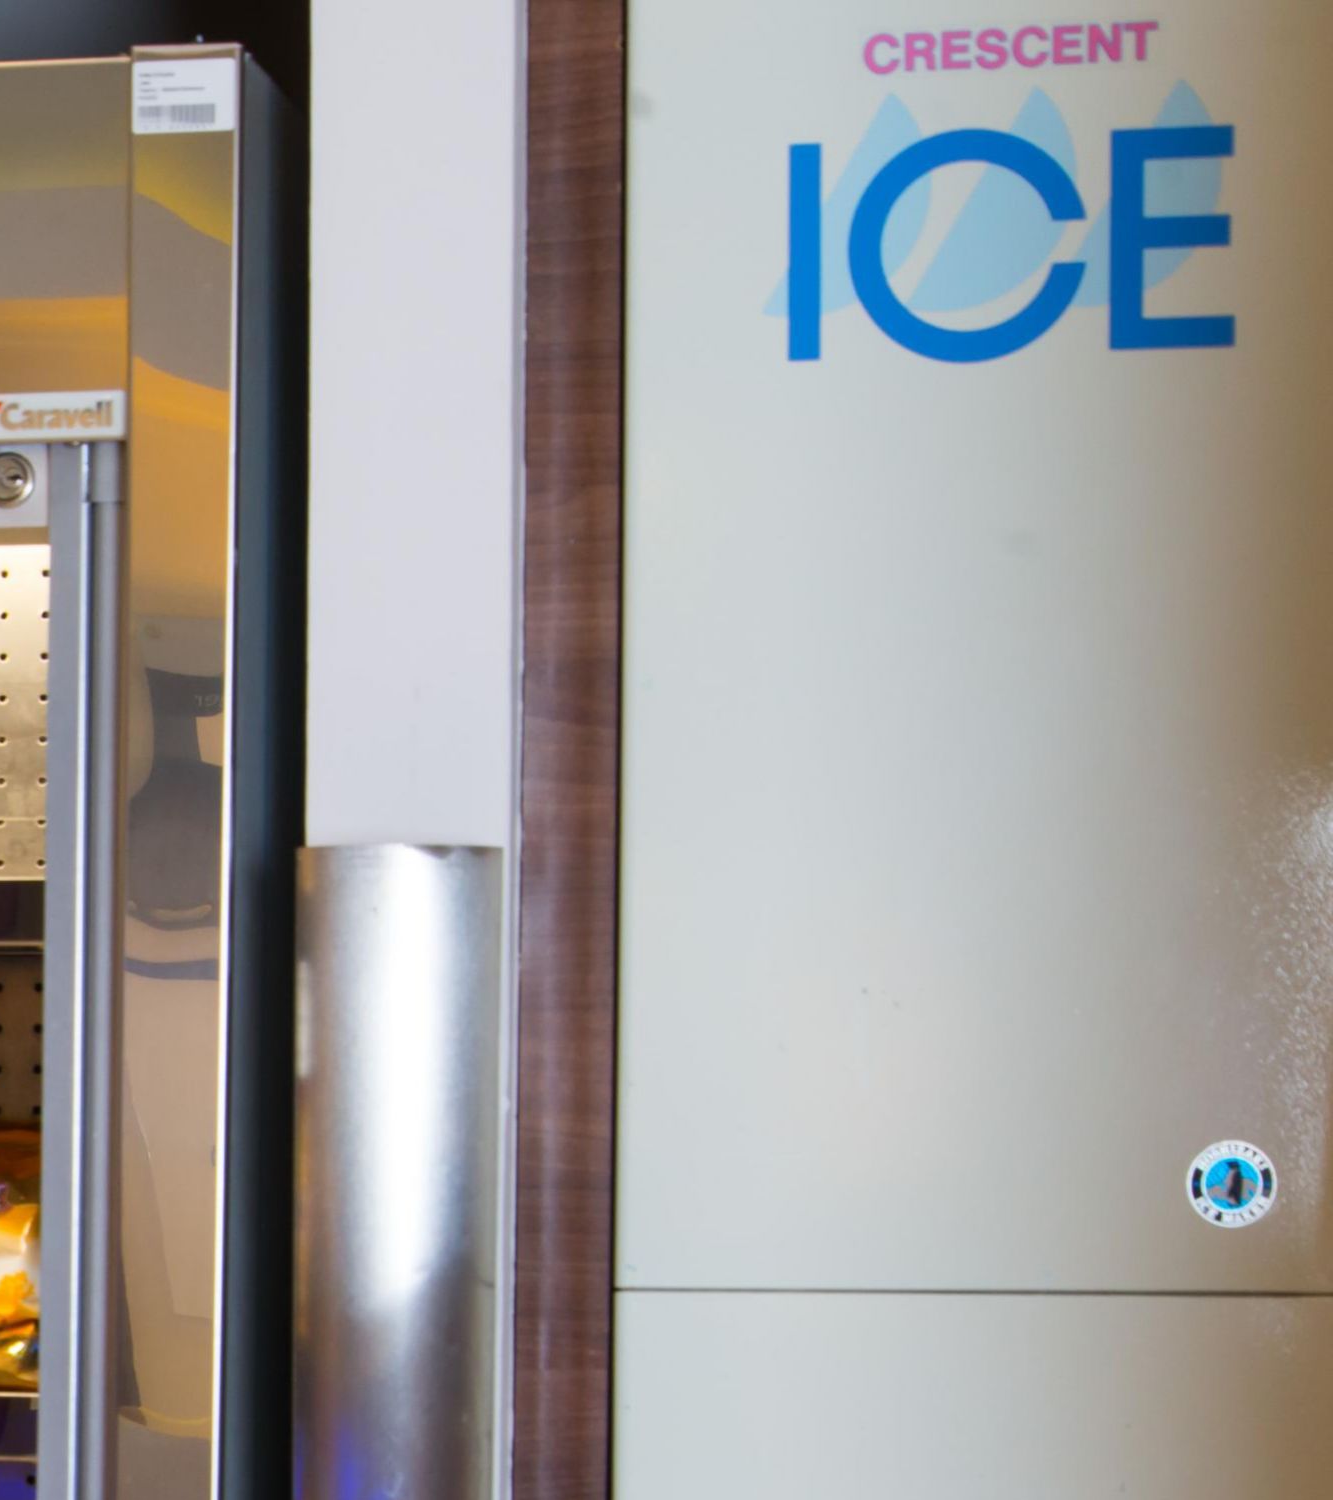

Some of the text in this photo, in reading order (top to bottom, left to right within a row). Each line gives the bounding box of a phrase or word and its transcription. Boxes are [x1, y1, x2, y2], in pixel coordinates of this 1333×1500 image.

[863, 21, 1159, 75] CRESCENT
[787, 125, 1236, 364] ICE
[0, 401, 113, 431] Caravell
